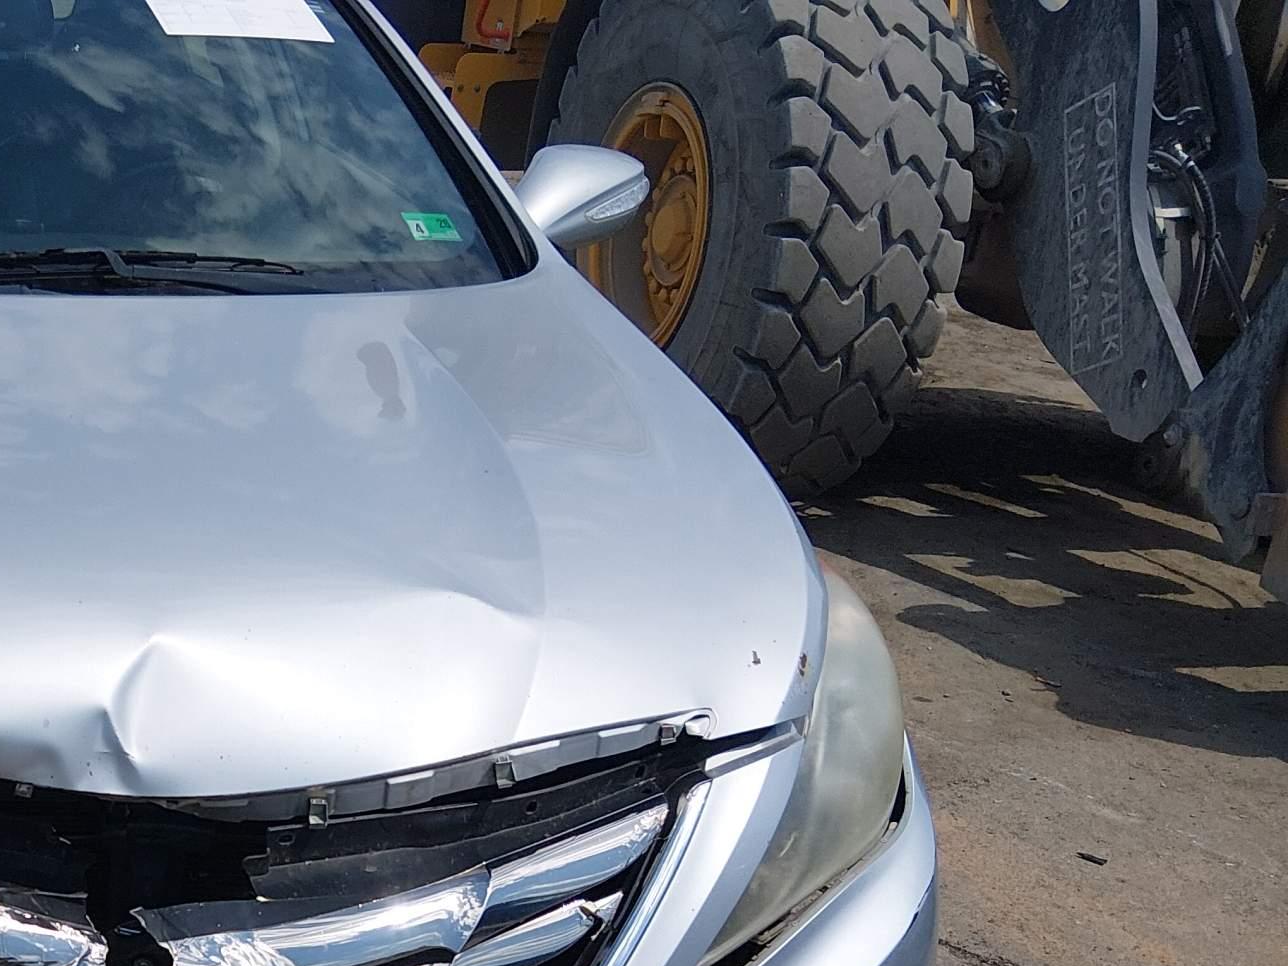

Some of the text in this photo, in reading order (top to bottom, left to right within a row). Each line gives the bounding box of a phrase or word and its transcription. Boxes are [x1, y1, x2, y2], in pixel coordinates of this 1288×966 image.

[415, 223, 425, 234] 4
[1094, 91, 1120, 358] DO NOT WALK
[1070, 261, 1091, 358] MAST
